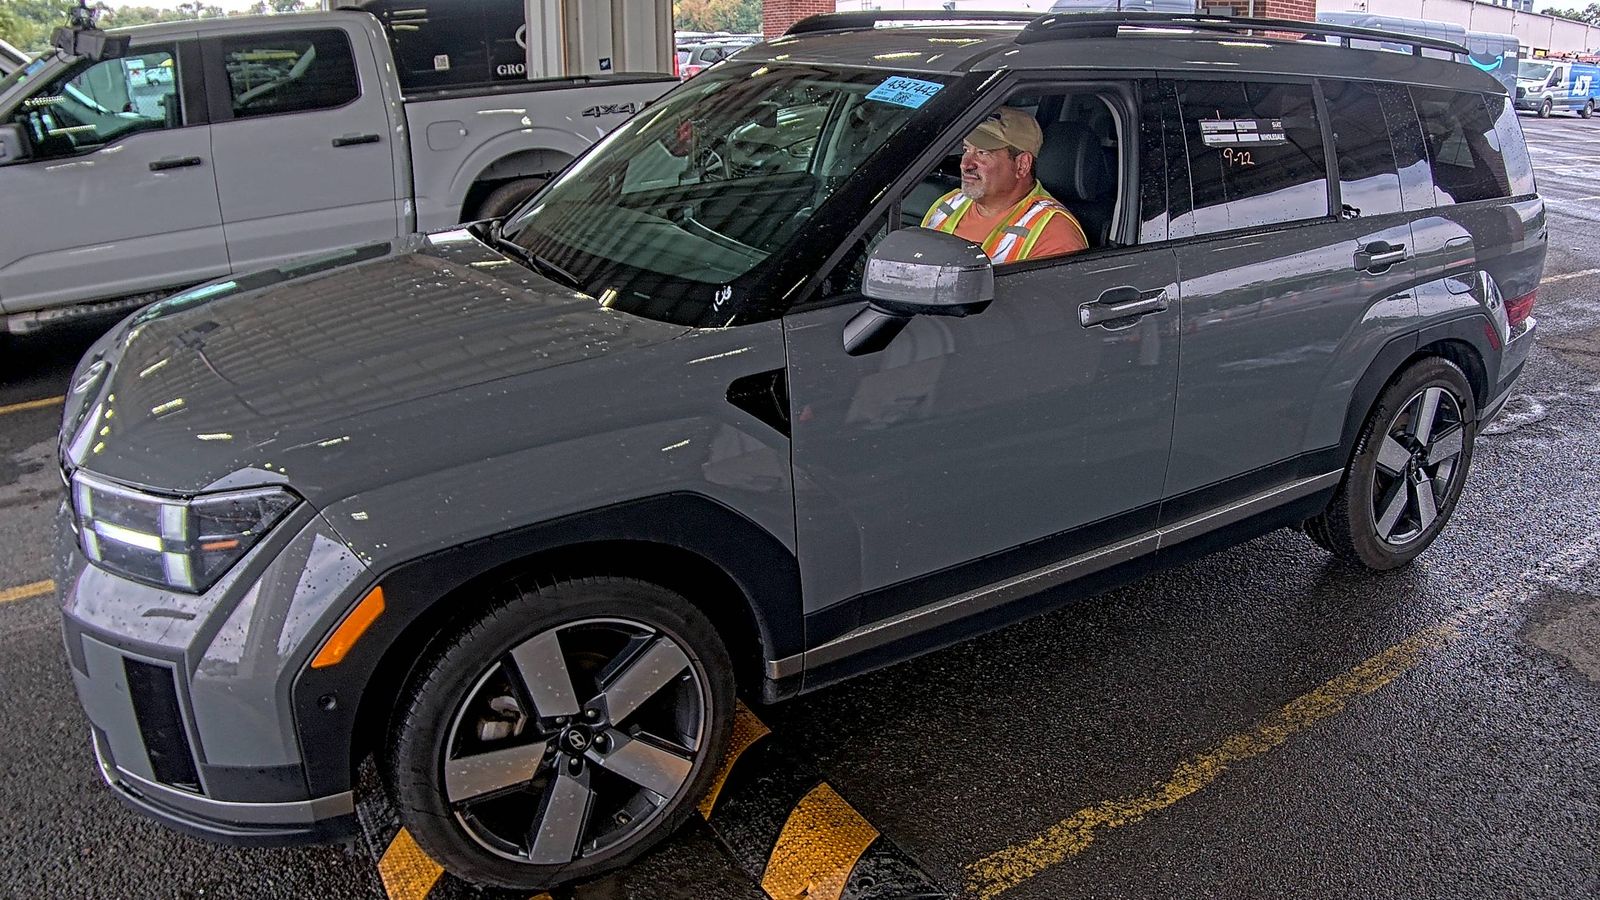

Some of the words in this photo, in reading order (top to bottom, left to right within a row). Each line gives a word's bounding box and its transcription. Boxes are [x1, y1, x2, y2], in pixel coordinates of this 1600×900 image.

[497, 64, 526, 75] GRO
[887, 79, 940, 97] 4347442
[1572, 75, 1593, 97] ADT
[1223, 148, 1255, 168] 9-22
